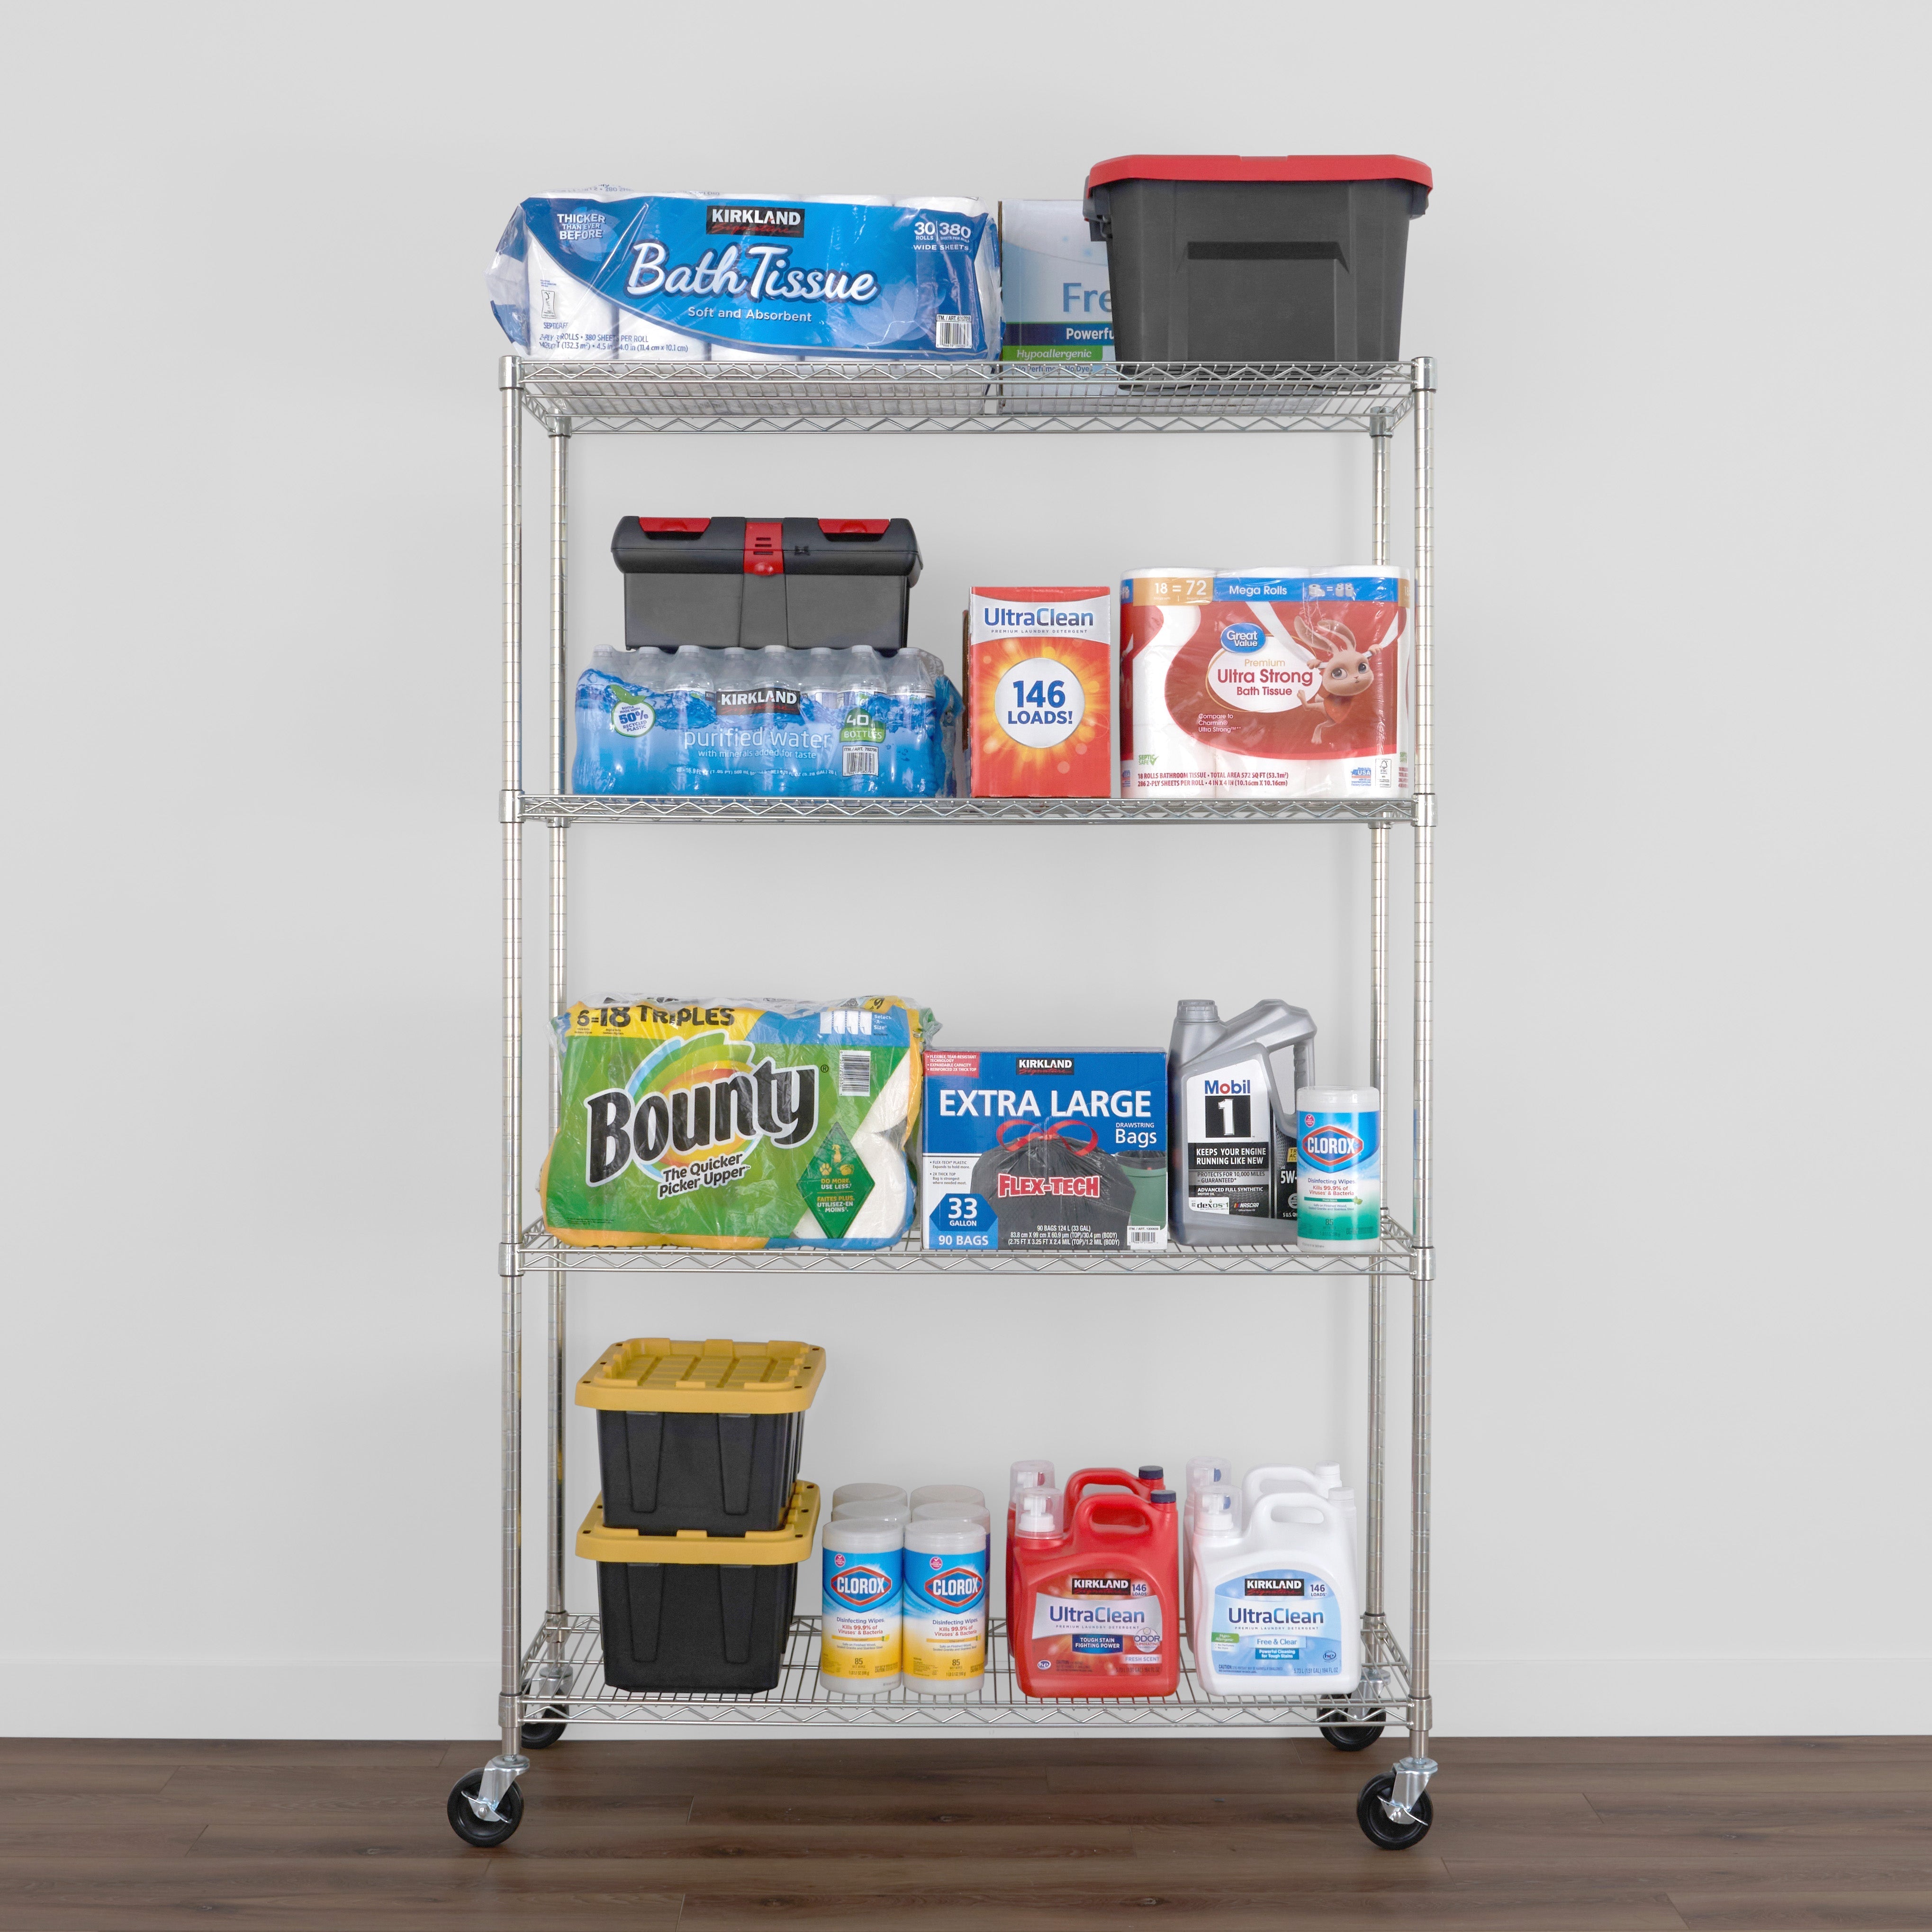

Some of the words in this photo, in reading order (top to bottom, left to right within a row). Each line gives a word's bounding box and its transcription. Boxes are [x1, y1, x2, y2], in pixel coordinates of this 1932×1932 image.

[557, 213, 606, 224] THICKER
[712, 209, 801, 226] KIRKLAND
[560, 230, 604, 240] BEFORE
[914, 222, 936, 235] 30
[939, 222, 971, 238] 380
[626, 242, 748, 295] Bath
[749, 245, 878, 301] Tissue
[688, 307, 713, 318] Soft
[718, 308, 741, 318] and
[746, 309, 812, 323] Absorbent
[1017, 349, 1092, 360] Hypoallergenic
[1155, 583, 1168, 594] 18
[1186, 580, 1207, 596] 72
[1229, 586, 1261, 597] Mega
[1264, 586, 1287, 595] Rolls
[984, 608, 1093, 627] UltraClean
[1227, 630, 1258, 641] Great
[1234, 639, 1258, 647] Value
[1217, 669, 1255, 683] Ultra
[1260, 669, 1313, 686] Strong
[721, 690, 797, 705] KIRKLAND
[1012, 680, 1065, 709] 146
[1237, 686, 1260, 696] Bath
[1263, 686, 1292, 696] Tissue
[619, 710, 649, 724] 50%
[623, 720, 647, 729] RECYCLED
[846, 714, 869, 725] 40
[1007, 711, 1073, 725] LOADS!
[684, 726, 764, 749] purified
[770, 731, 831, 748] water
[844, 731, 882, 739] BOTTLES
[719, 749, 752, 758] minerals
[782, 749, 792, 758] for
[1019, 1059, 1072, 1068] KIRKLAND
[1205, 1080, 1250, 1094] Mobil
[939, 1090, 1041, 1117] EXTRA
[1051, 1090, 1151, 1117] LARGE
[587, 1058, 815, 1183] Bounty
[1218, 1098, 1235, 1136] 1
[1115, 1129, 1157, 1147] Bags
[1308, 1137, 1355, 1154] CLOROX
[663, 1168, 687, 1182] The
[690, 1154, 742, 1176] Quicker
[660, 1178, 701, 1197] Picker
[998, 1173, 1100, 1199] FLEX-TECH
[948, 1197, 977, 1219] 33
[939, 1235, 953, 1246] 90
[957, 1235, 988, 1246] BAGS
[837, 1577, 885, 1594] CLOROX
[933, 1577, 978, 1596] CLOROX
[1074, 1580, 1129, 1589] KIRKLAND
[1247, 1580, 1302, 1589] KIRKLAND
[1050, 1606, 1145, 1623] UltraClean
[1228, 1608, 1323, 1624] UltraClean
